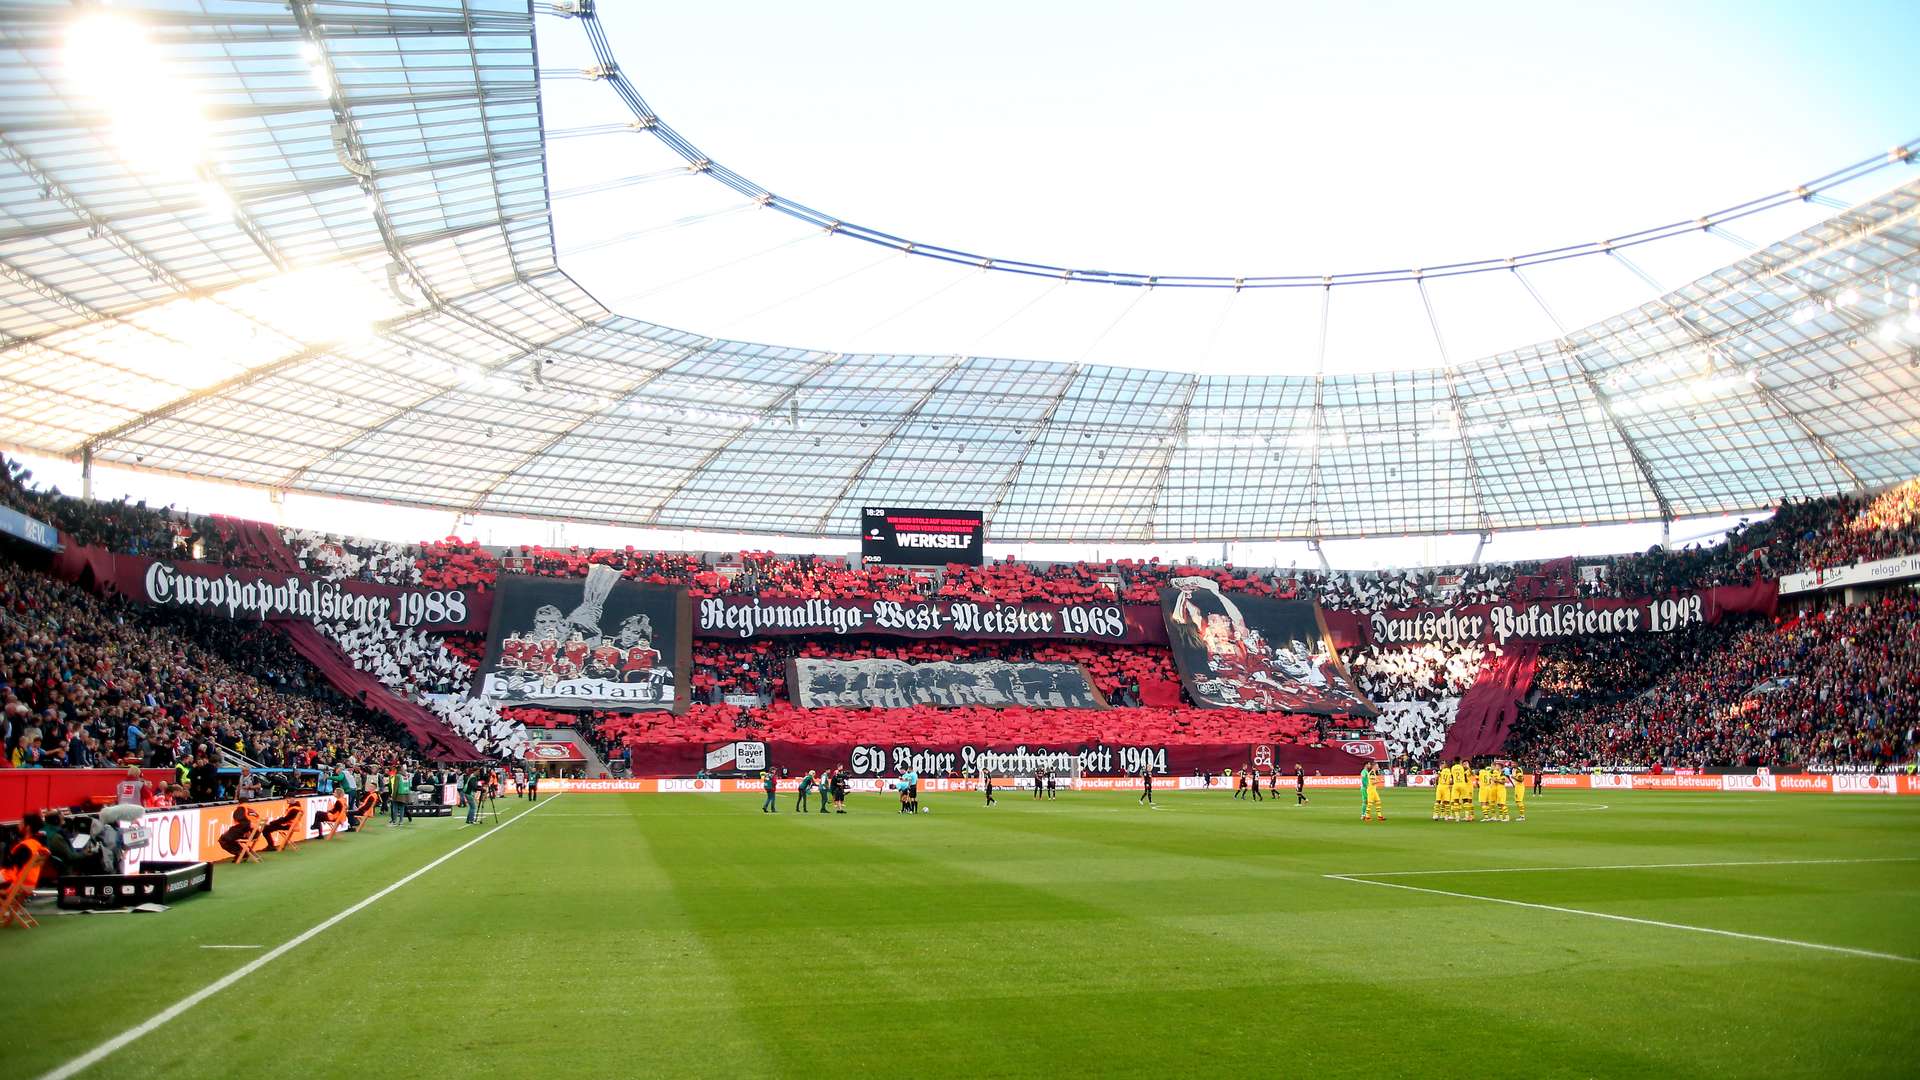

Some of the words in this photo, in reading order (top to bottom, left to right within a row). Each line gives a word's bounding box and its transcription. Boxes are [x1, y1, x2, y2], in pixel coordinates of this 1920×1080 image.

[896, 532, 972, 549] WERKSELF
[146, 561, 390, 623] Europapokalsieger
[398, 590, 467, 627] 1988
[700, 598, 1053, 638] Regionalliga-West-Meister
[1059, 606, 1124, 637] 1968
[1371, 608, 1483, 648] Deutscher
[1490, 601, 1641, 646] Pokalsieger
[738, 749, 763, 758] Bayer
[893, 746, 956, 775] Bayer
[1078, 745, 1112, 773] seit
[1118, 746, 1168, 774] 1904
[664, 779, 715, 790] DITCON
[1116, 779, 1137, 788] und
[1633, 776, 1660, 786] Service
[1662, 776, 1677, 786] und
[1678, 776, 1722, 789] Betreuung
[1728, 775, 1770, 788] DITCON
[1781, 776, 1827, 789] ditcon.de
